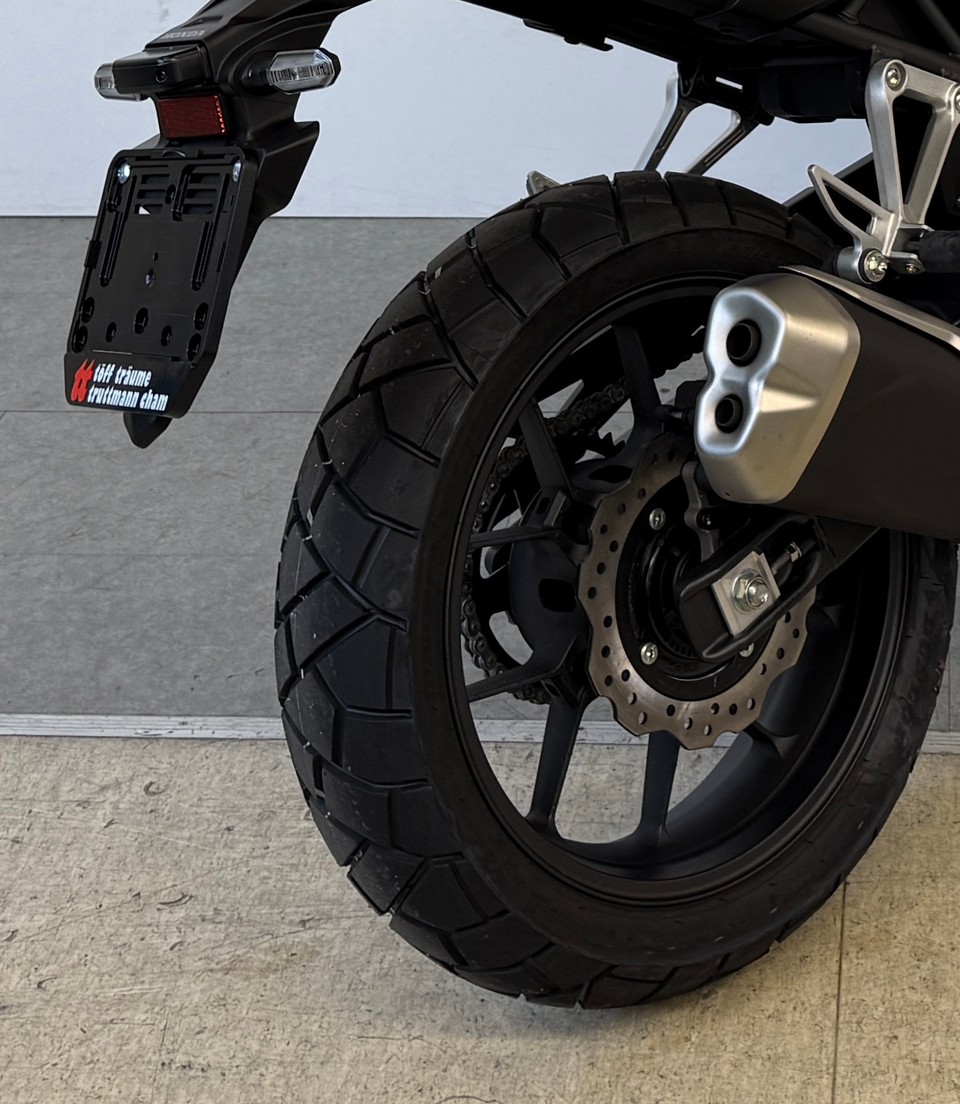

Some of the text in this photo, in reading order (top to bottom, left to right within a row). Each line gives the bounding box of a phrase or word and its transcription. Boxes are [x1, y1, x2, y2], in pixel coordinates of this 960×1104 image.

[93, 363, 152, 388] töff träume
[87, 384, 169, 411] truttmann cham
